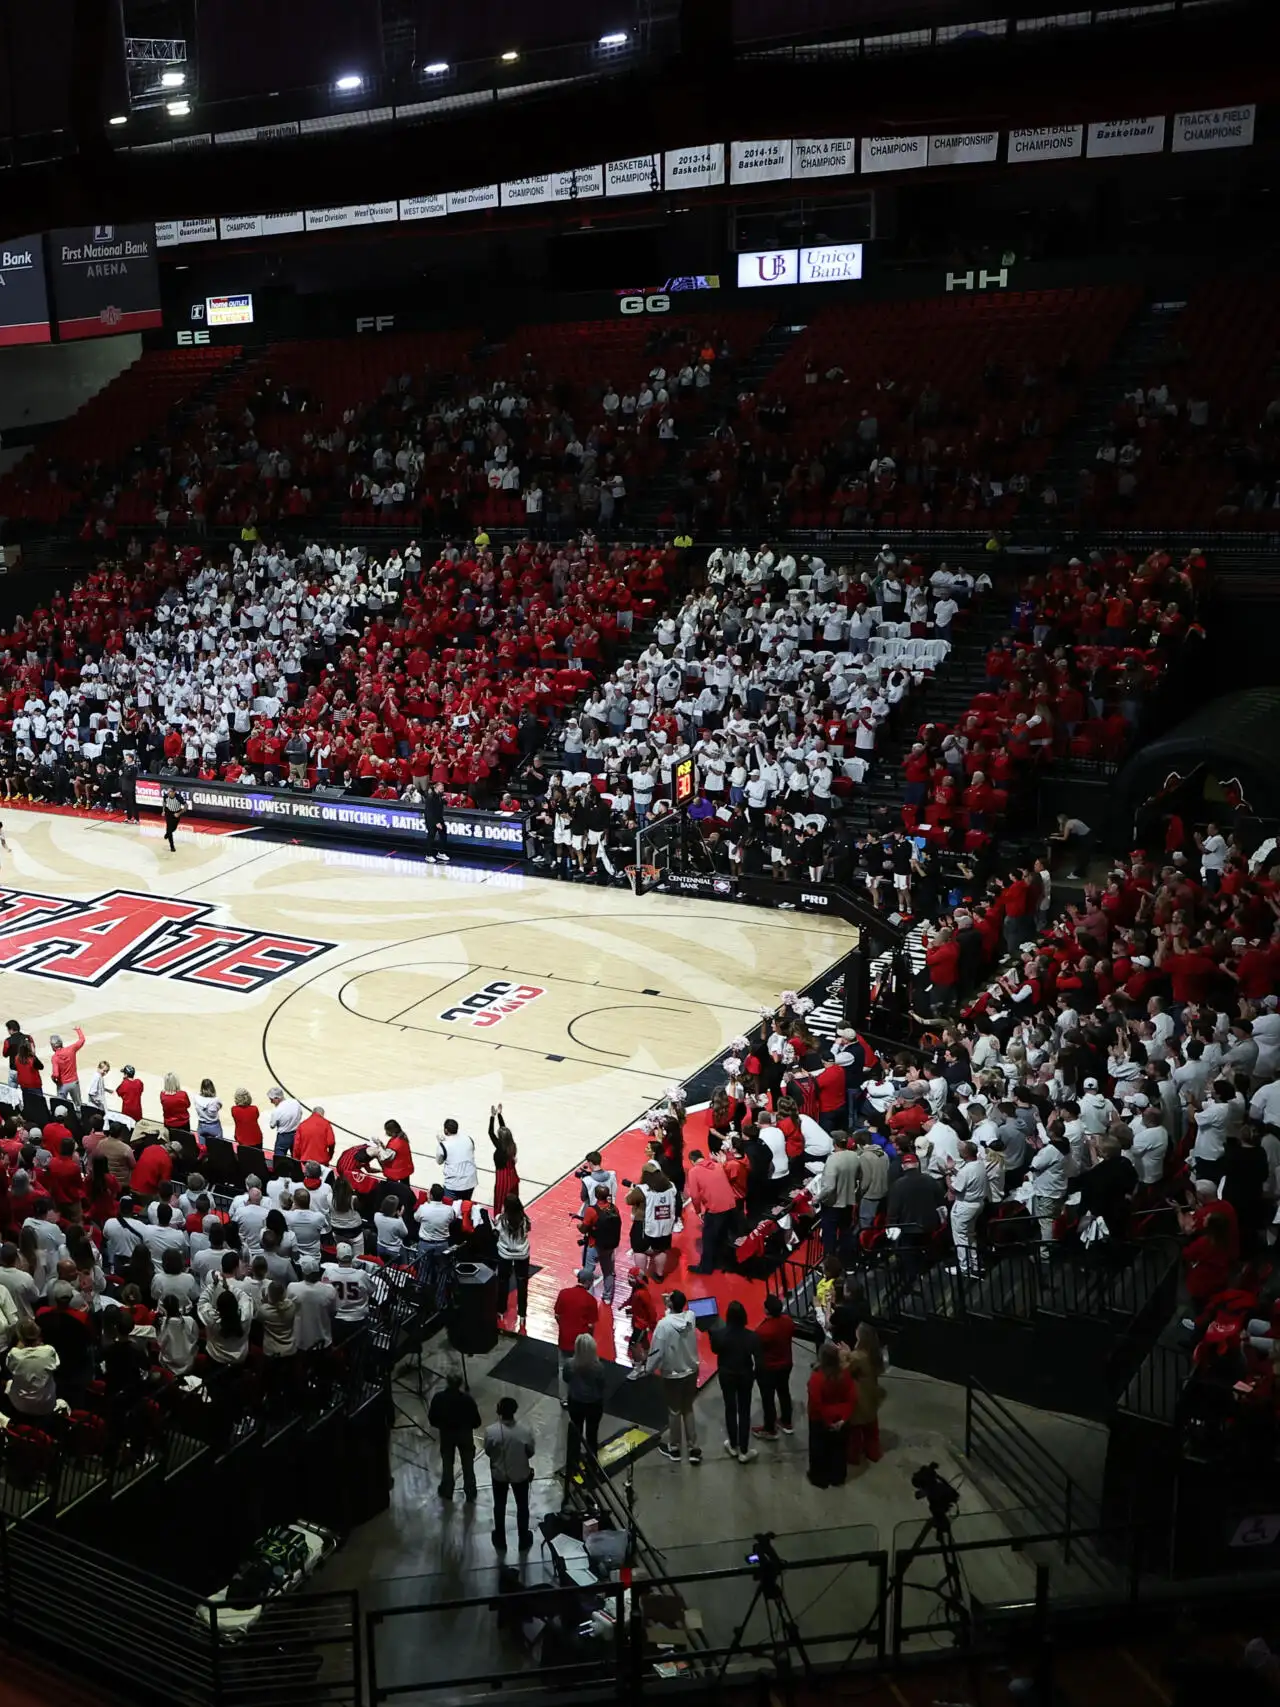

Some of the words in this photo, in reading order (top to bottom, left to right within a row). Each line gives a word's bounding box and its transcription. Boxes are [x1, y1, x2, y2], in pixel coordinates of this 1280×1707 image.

[1179, 112, 1211, 126] TRACK
[1213, 112, 1220, 123] &
[1223, 109, 1250, 122] FIELD
[1096, 126, 1154, 139] Basketball
[1183, 125, 1242, 141] CHAMPIONS
[796, 144, 821, 156] TRACK
[823, 143, 828, 153] &
[831, 141, 851, 151] FIELD
[934, 134, 993, 149] CHAMPIONSHIP
[1015, 137, 1073, 152] CHAMPIONS
[744, 146, 778, 159] 2014-15
[870, 142, 918, 156] CHAMPIONS
[608, 159, 656, 172] BASKETBALL
[678, 152, 711, 165] 2013-14
[738, 155, 784, 169] Basketball
[801, 155, 846, 169] CHAMPIONS
[673, 162, 717, 176] Basketball
[508, 186, 545, 198] CHAMPIONS
[575, 184, 600, 194] IVISION
[409, 195, 438, 205] CHAMPION
[451, 197, 468, 205] West
[468, 193, 494, 203] Division
[354, 209, 369, 217] West
[369, 207, 393, 216] Division
[404, 206, 420, 216] WEST
[420, 204, 444, 214] DIVISION
[310, 216, 324, 224] West
[325, 213, 348, 221] Division
[226, 222, 256, 232] CHAMPIONS
[62, 246, 81, 261] First
[83, 243, 122, 259] National
[125, 240, 148, 255] Bank
[807, 249, 856, 265] Unico
[2, 251, 32, 267] Bank
[86, 262, 128, 278] ARENA
[811, 263, 852, 279] Bank
[945, 268, 1008, 291] HH
[620, 294, 670, 314] GG
[356, 315, 395, 333] FF
[176, 330, 210, 346] EE
[677, 773, 691, 799] 30
[192, 792, 252, 810] GUARANTEED
[253, 799, 290, 815] LOWEST
[292, 803, 320, 819] PRICE
[322, 807, 337, 821] ON
[338, 809, 389, 828] KITCHENS,
[392, 815, 428, 833] BATHS,
[473, 825, 483, 838] &
[484, 827, 523, 842] DOORS
[668, 875, 711, 885] CENTENNIAL
[680, 882, 699, 890] BANK
[801, 893, 828, 905] PRO
